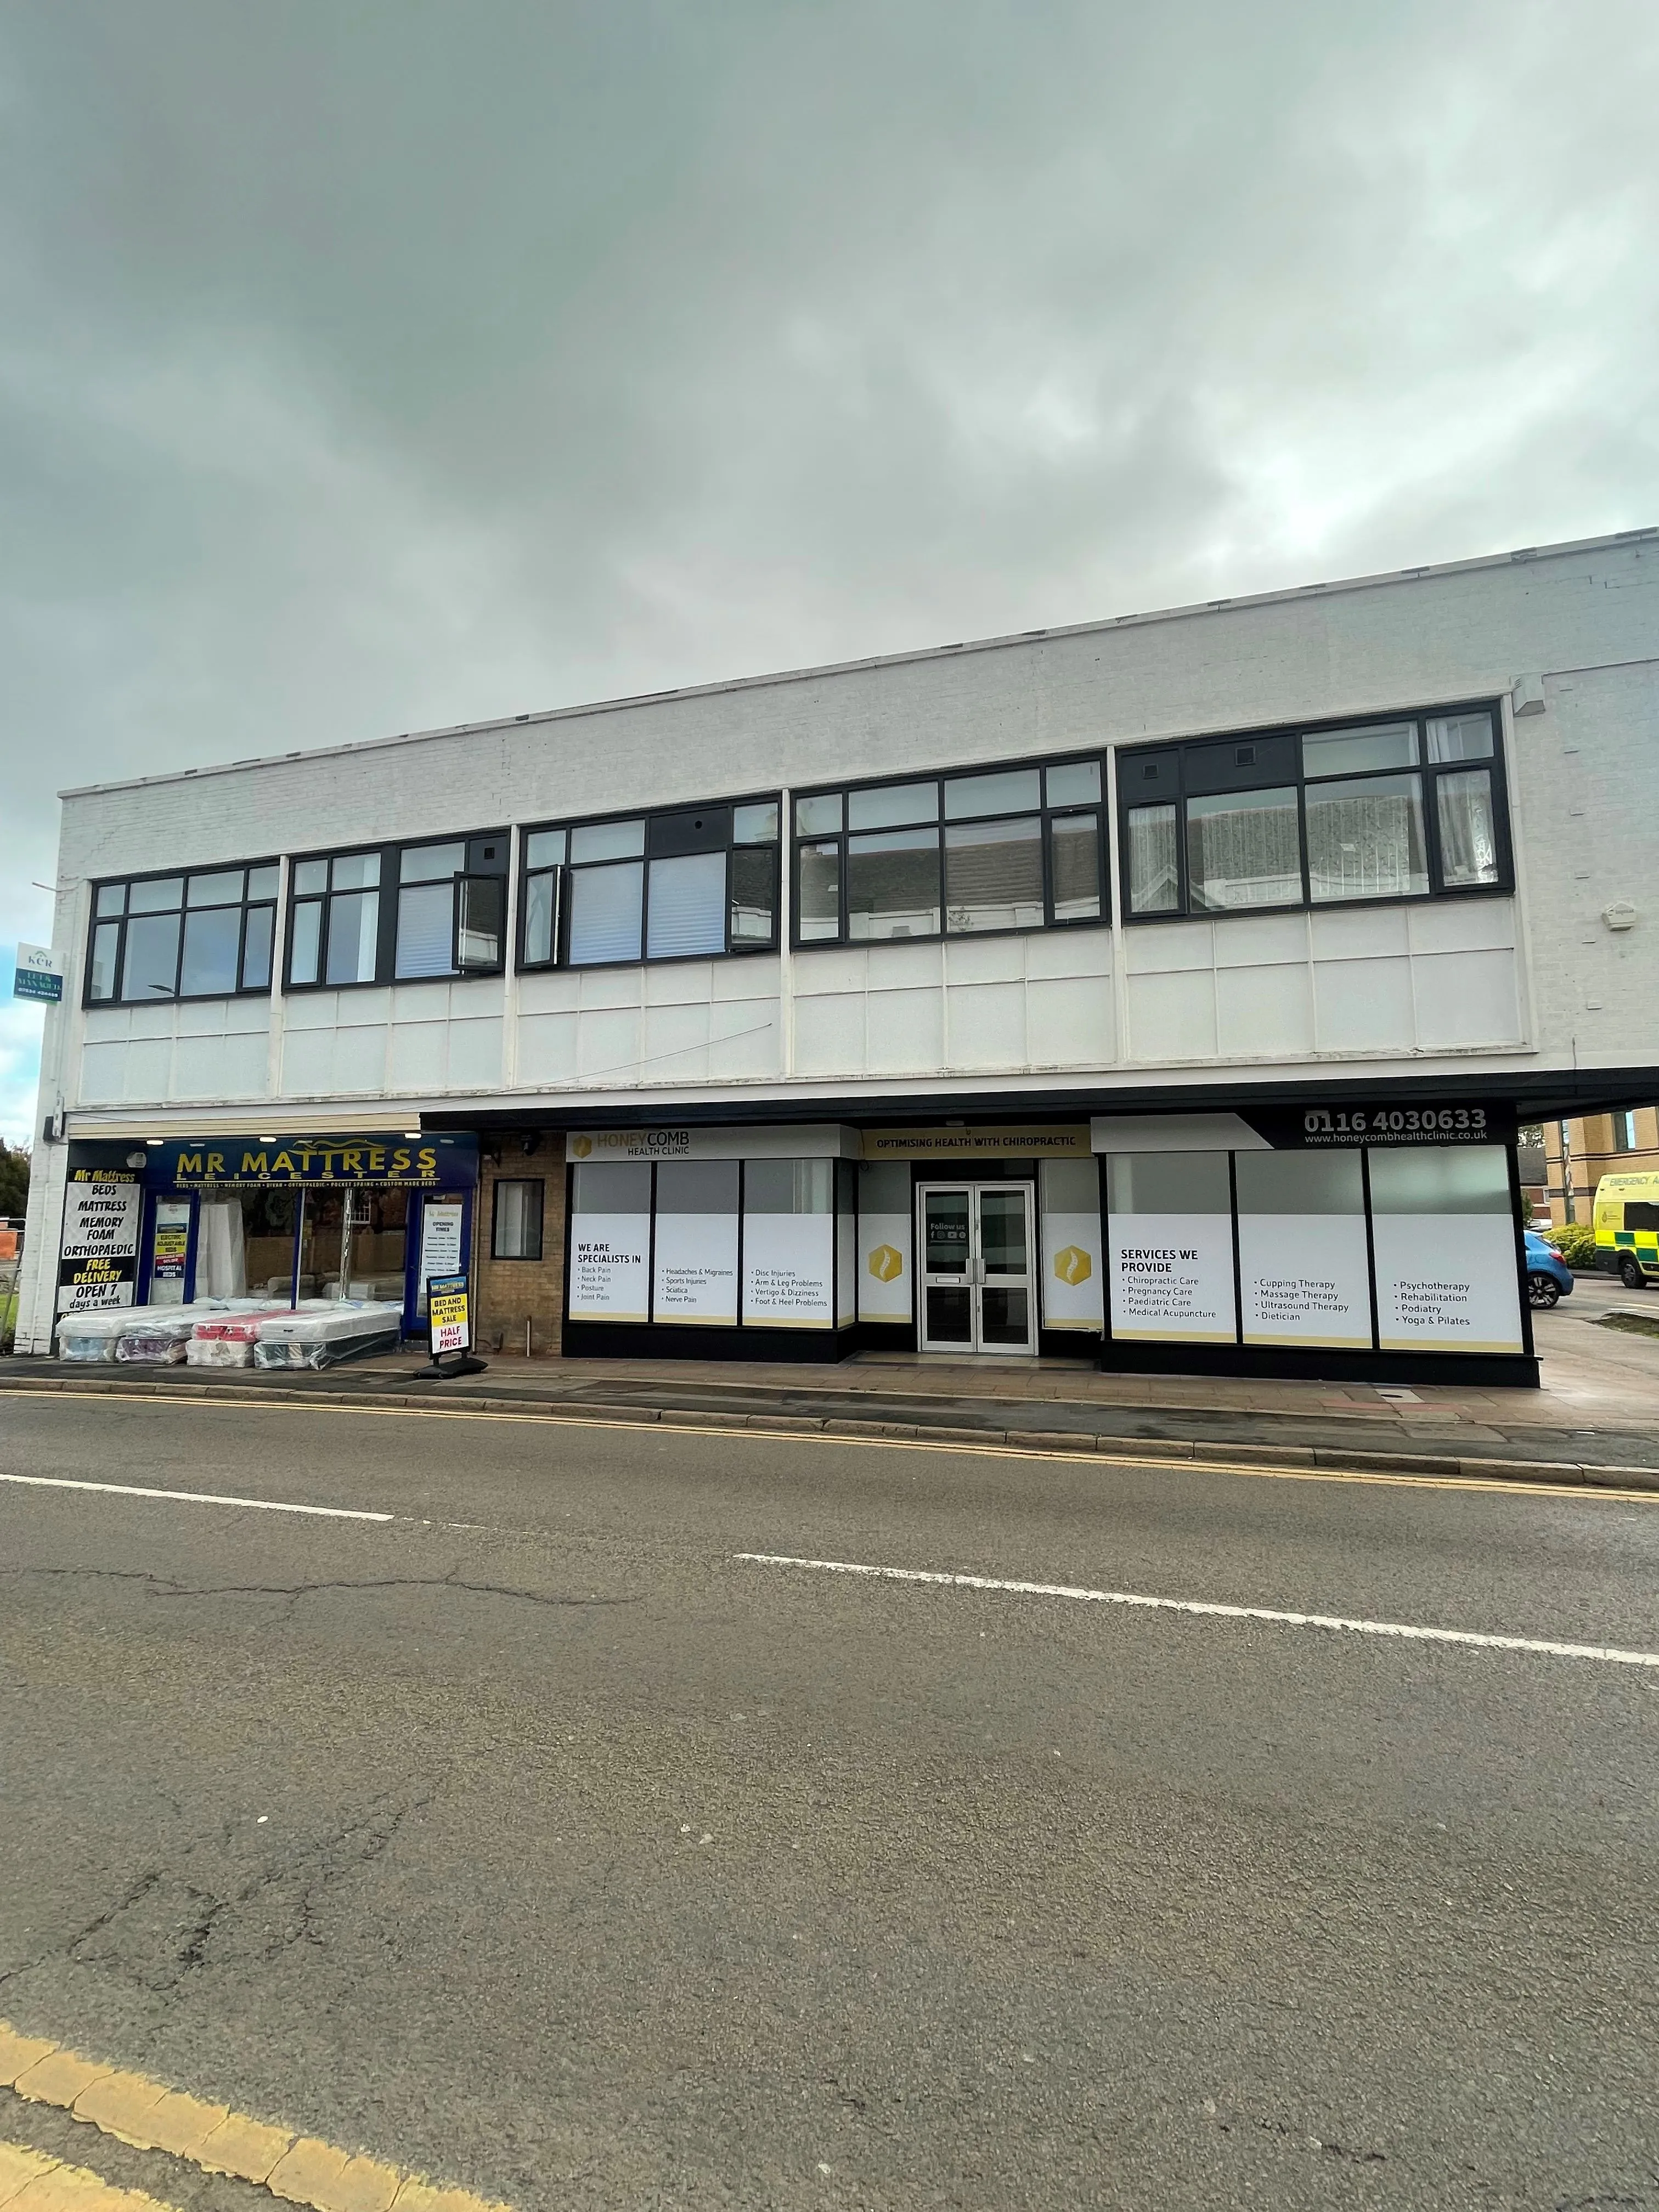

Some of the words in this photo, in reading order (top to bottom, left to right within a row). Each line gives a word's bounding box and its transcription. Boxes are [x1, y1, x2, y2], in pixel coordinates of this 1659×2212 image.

[1305, 1113, 1365, 1132] 0116
[1373, 1109, 1486, 1130] 4030633
[1305, 1130, 1488, 1143] www.honeycombhealthclinic.co.uk
[877, 1138, 933, 1148] OPTIMISING
[934, 1137, 971, 1147] HEALTH
[974, 1137, 1000, 1147] WITH
[1002, 1136, 1076, 1146] CHIROPRACTIC
[628, 1147, 659, 1156] HEALTH
[662, 1146, 690, 1155] CLINIC
[177, 1152, 225, 1172] MR
[241, 1148, 437, 1172] MATTRESS
[74, 1169, 91, 1182] Mr
[92, 1170, 135, 1183] Mattress
[177, 1170, 436, 1180] LEICESTER
[92, 1184, 117, 1195] BEDS
[78, 1200, 127, 1212] MATTRESS
[79, 1217, 124, 1228] MEMORY
[87, 1229, 115, 1240] FOAM
[64, 1244, 134, 1256] ORTHOPAEDIC
[578, 1243, 591, 1251] WE
[578, 1254, 630, 1263] SPECIALISTS
[1121, 1249, 1176, 1260] SERVICES
[1179, 1250, 1198, 1260] WE
[86, 1259, 111, 1271] FREE
[1121, 1262, 1172, 1272] PROVIDE
[73, 1270, 122, 1284] DELIVERY
[704, 1269, 733, 1277] Migraines
[771, 1270, 795, 1278] Injuries
[666, 1277, 684, 1285] Sports
[777, 1279, 789, 1288] Leg
[1127, 1276, 1177, 1285] Chiropractic
[1260, 1279, 1296, 1289] Cupping
[1299, 1280, 1335, 1290] Therapy
[76, 1284, 107, 1298] OPEN
[111, 1284, 117, 1296] 7
[1128, 1286, 1171, 1296] Pregnancy
[1400, 1282, 1470, 1292] Psychotherapy
[755, 1288, 779, 1297] Vertigo
[1261, 1290, 1300, 1300] Massage
[1301, 1290, 1339, 1301] Therapy
[1401, 1293, 1467, 1302] Rehabilitation
[70, 1299, 90, 1310] days
[101, 1295, 121, 1306] week
[448, 1297, 461, 1306] AND
[1128, 1297, 1170, 1306] Paediatric
[432, 1305, 465, 1316] MATTRESS
[1261, 1301, 1310, 1310] Ultrasound
[1312, 1302, 1348, 1313] Therapy
[1401, 1304, 1441, 1314] Podiatry
[1129, 1308, 1161, 1316] Medical
[1163, 1309, 1216, 1318] Acupuncture
[1262, 1312, 1300, 1321] Dietician
[442, 1314, 456, 1323] SALE
[1402, 1316, 1425, 1326] Yoga
[1438, 1316, 1470, 1325] Pilates
[441, 1326, 460, 1337] HALF
[439, 1336, 462, 1349] PRICE
